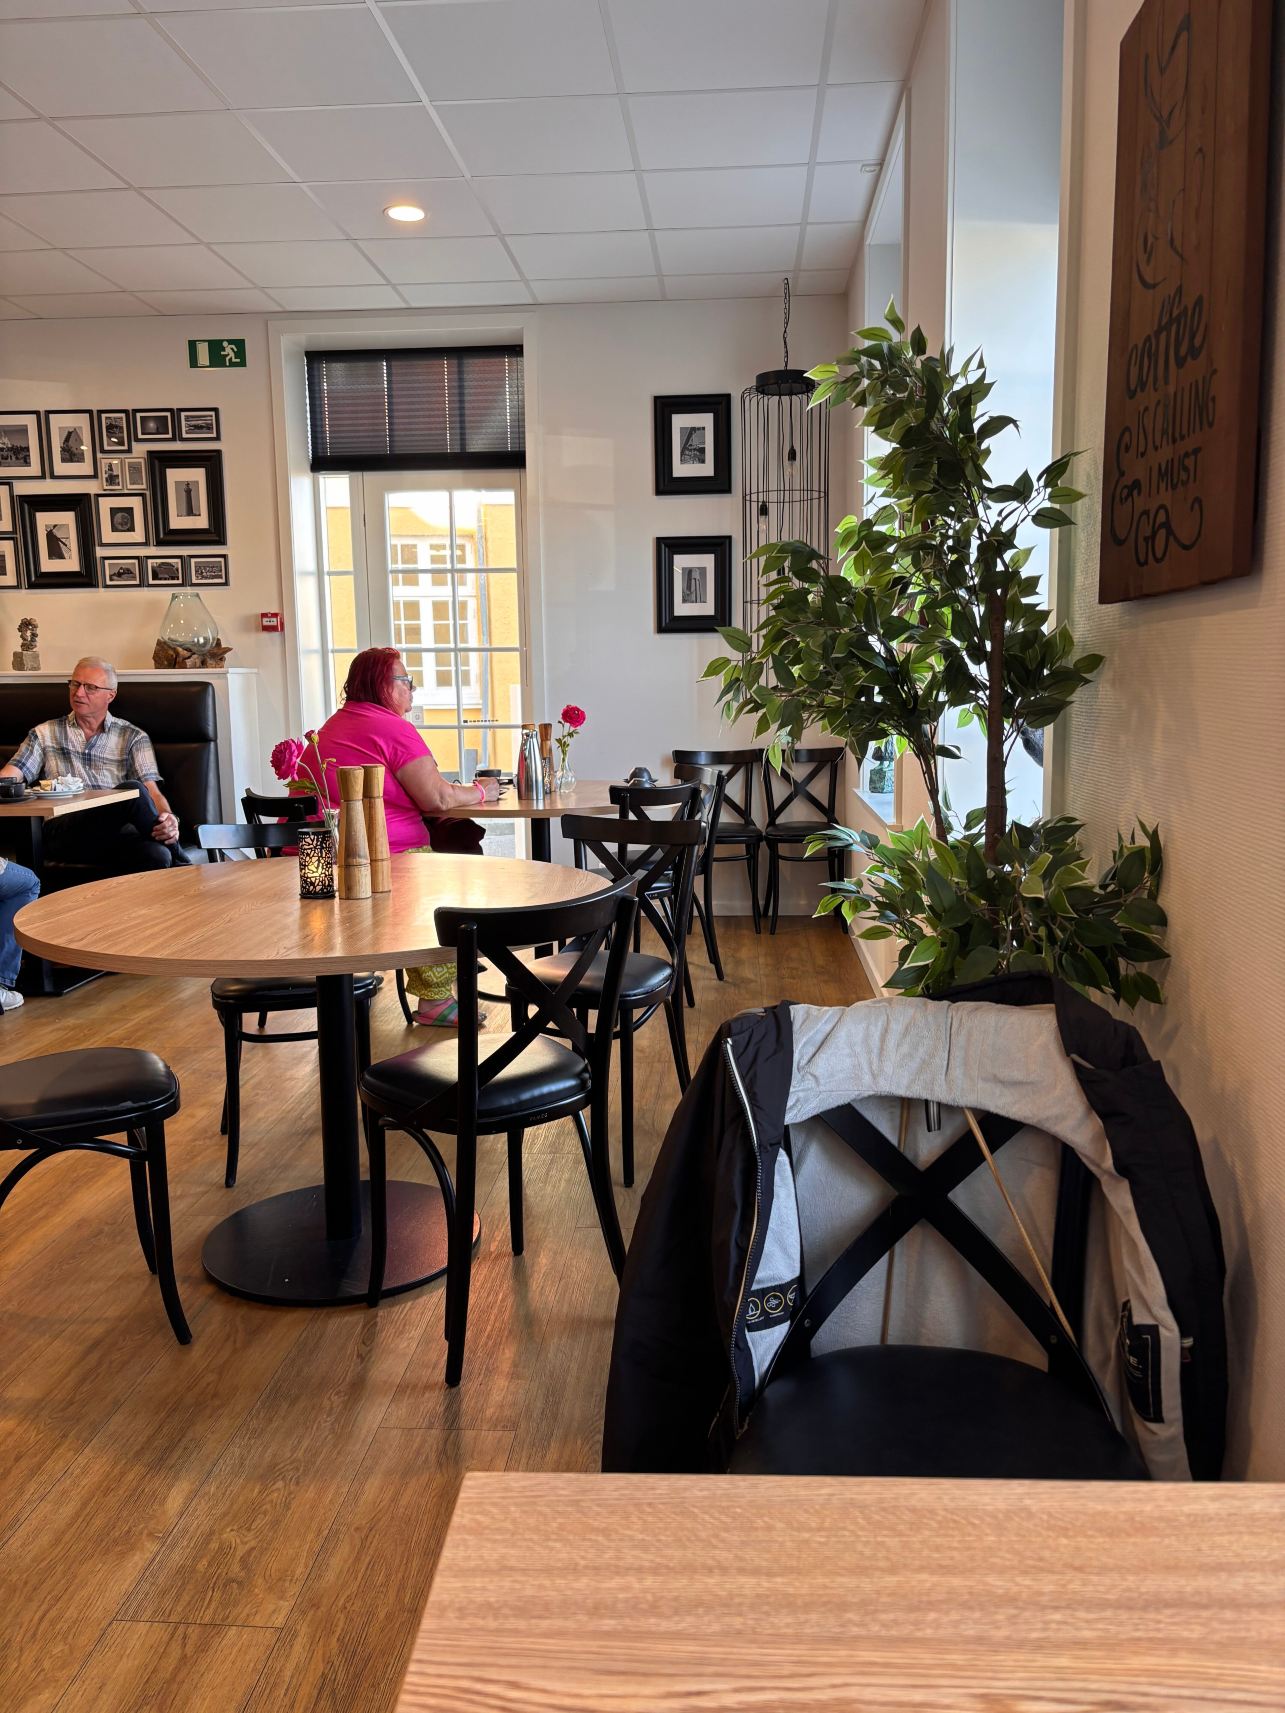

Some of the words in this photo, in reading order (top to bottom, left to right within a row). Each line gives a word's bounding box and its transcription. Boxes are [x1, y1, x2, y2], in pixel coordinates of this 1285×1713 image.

[1126, 284, 1208, 400] coffee
[1136, 405, 1149, 459] IS
[1152, 368, 1217, 451] CALLING
[1156, 446, 1202, 495] MUST
[1134, 496, 1203, 567] GO
